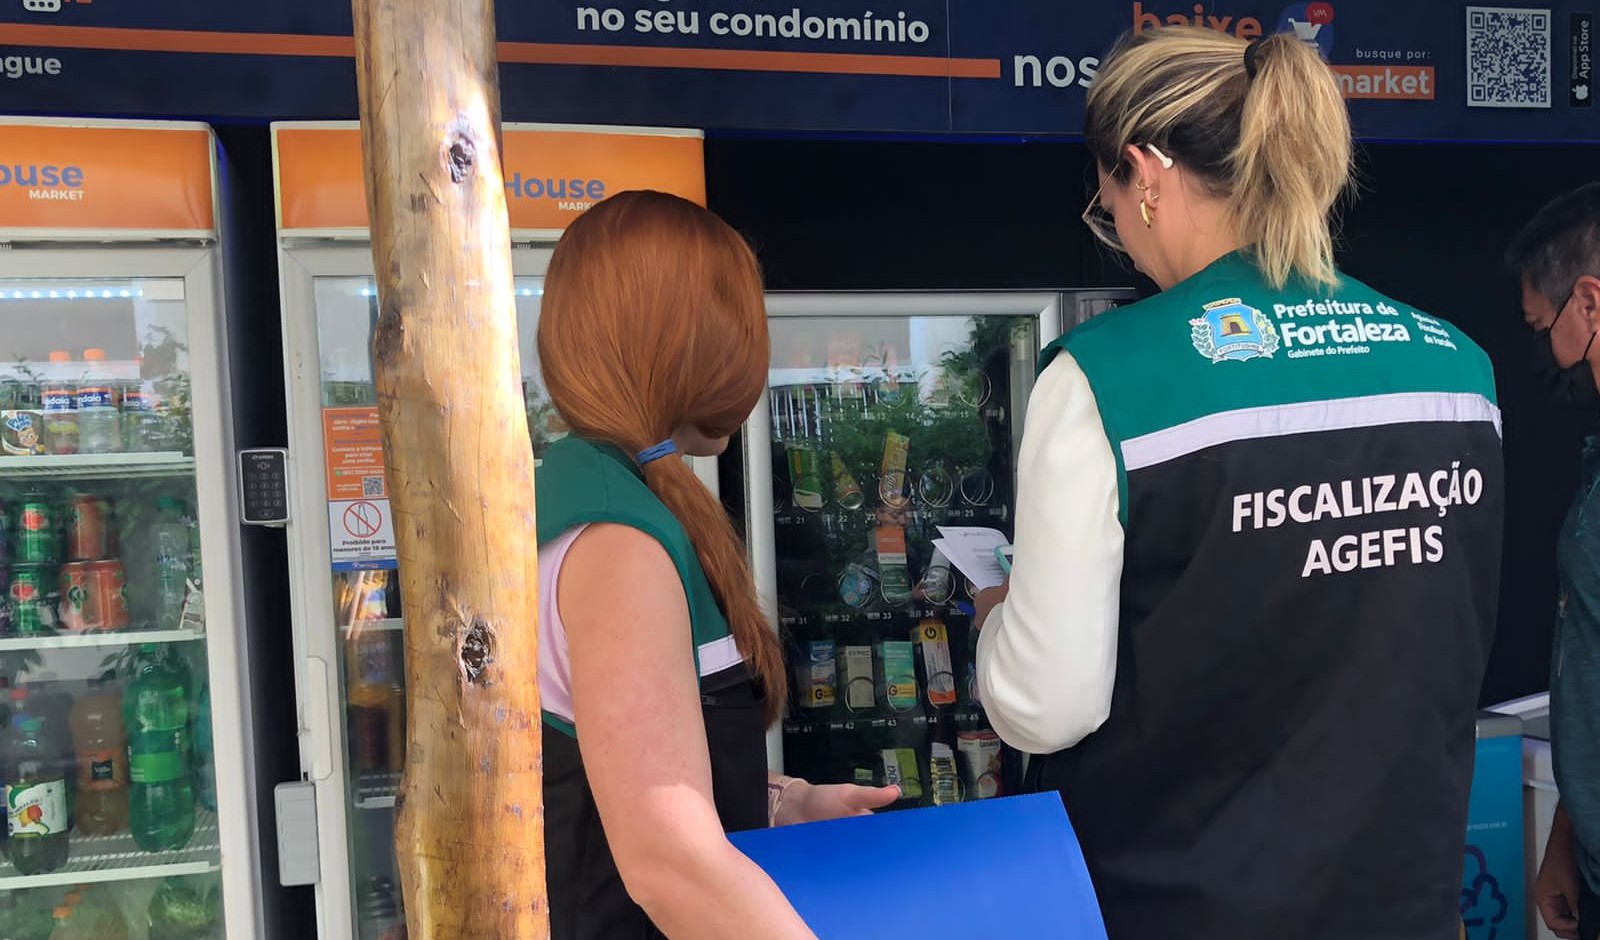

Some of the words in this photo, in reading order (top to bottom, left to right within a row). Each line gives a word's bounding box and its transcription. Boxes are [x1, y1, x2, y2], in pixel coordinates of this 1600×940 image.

[577, 7, 625, 32] no
[634, 9, 698, 34] seu
[709, 9, 930, 43] condomínio
[1579, 20, 1589, 52] Store
[1356, 48, 1402, 60] busque
[1407, 49, 1431, 61] por:
[0, 55, 62, 79] gue
[1579, 54, 1591, 79] App
[28, 189, 85, 201] MARKET
[1273, 298, 1373, 320] Prefeitura
[1376, 301, 1400, 316] de
[1279, 316, 1412, 348] Fortaleza
[1287, 347, 1325, 360] Gabinete
[1326, 346, 1337, 356] do
[1337, 345, 1370, 355] Prefeito
[1232, 460, 1483, 532] FISCALIZAÇÃO
[838, 515, 848, 523] 22
[1301, 525, 1444, 578] AGEFIS
[882, 612, 892, 620] 33
[924, 610, 935, 618] 34
[814, 689, 825, 700] G
[928, 716, 938, 724] 44
